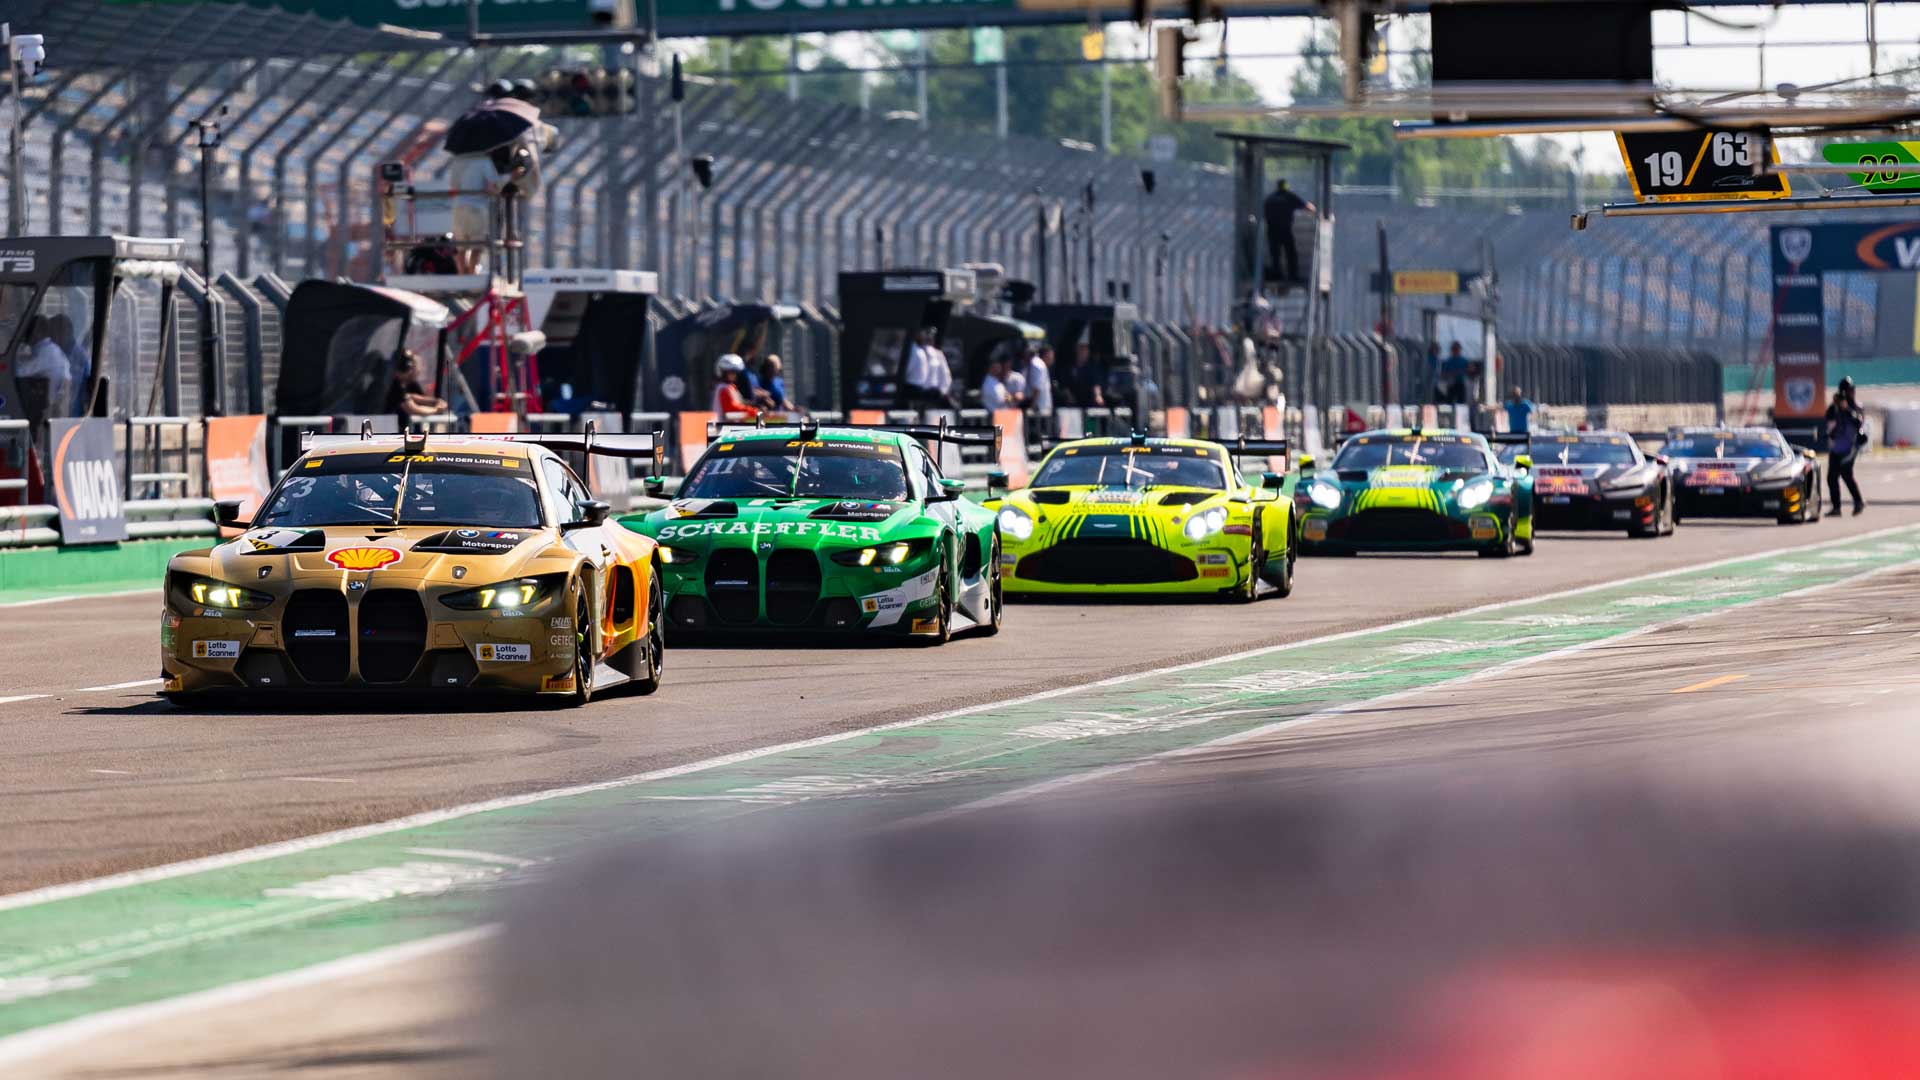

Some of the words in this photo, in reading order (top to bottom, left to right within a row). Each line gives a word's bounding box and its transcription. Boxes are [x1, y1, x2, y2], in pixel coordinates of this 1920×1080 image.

[1644, 151, 1683, 187] 19
[1712, 131, 1752, 167] 63
[1858, 154, 1900, 186] 90
[828, 442, 874, 450] WITTMANN
[388, 455, 435, 463] DTM
[68, 459, 119, 519] VAICO
[293, 477, 317, 498] 3
[656, 520, 882, 541] SCHAEFFLER
[462, 540, 516, 549] Motorsport
[208, 641, 227, 649] Lotto
[551, 635, 573, 646] GETEC
[208, 649, 236, 657] Scanner
[495, 653, 528, 661] Scanner
